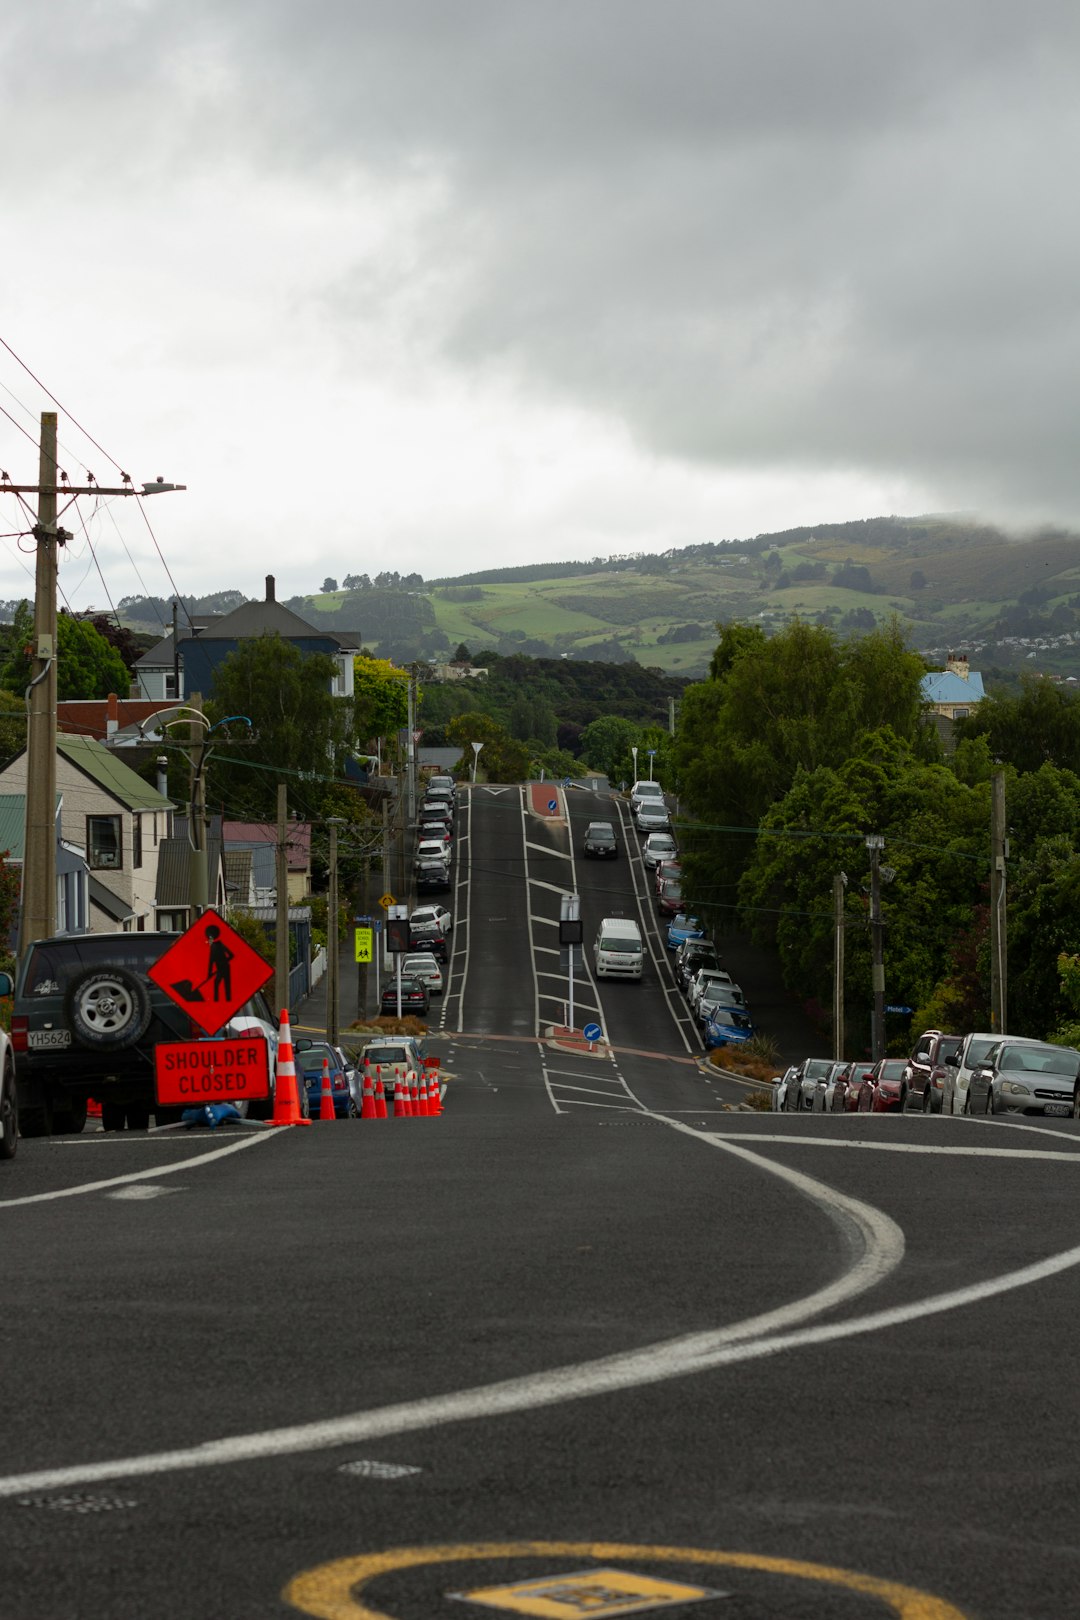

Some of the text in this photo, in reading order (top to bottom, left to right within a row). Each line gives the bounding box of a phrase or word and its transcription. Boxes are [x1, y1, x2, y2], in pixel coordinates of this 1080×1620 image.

[29, 1032, 71, 1046] YH5624
[165, 1047, 258, 1071] SHOULDER
[179, 1073, 247, 1094] CLOSED
